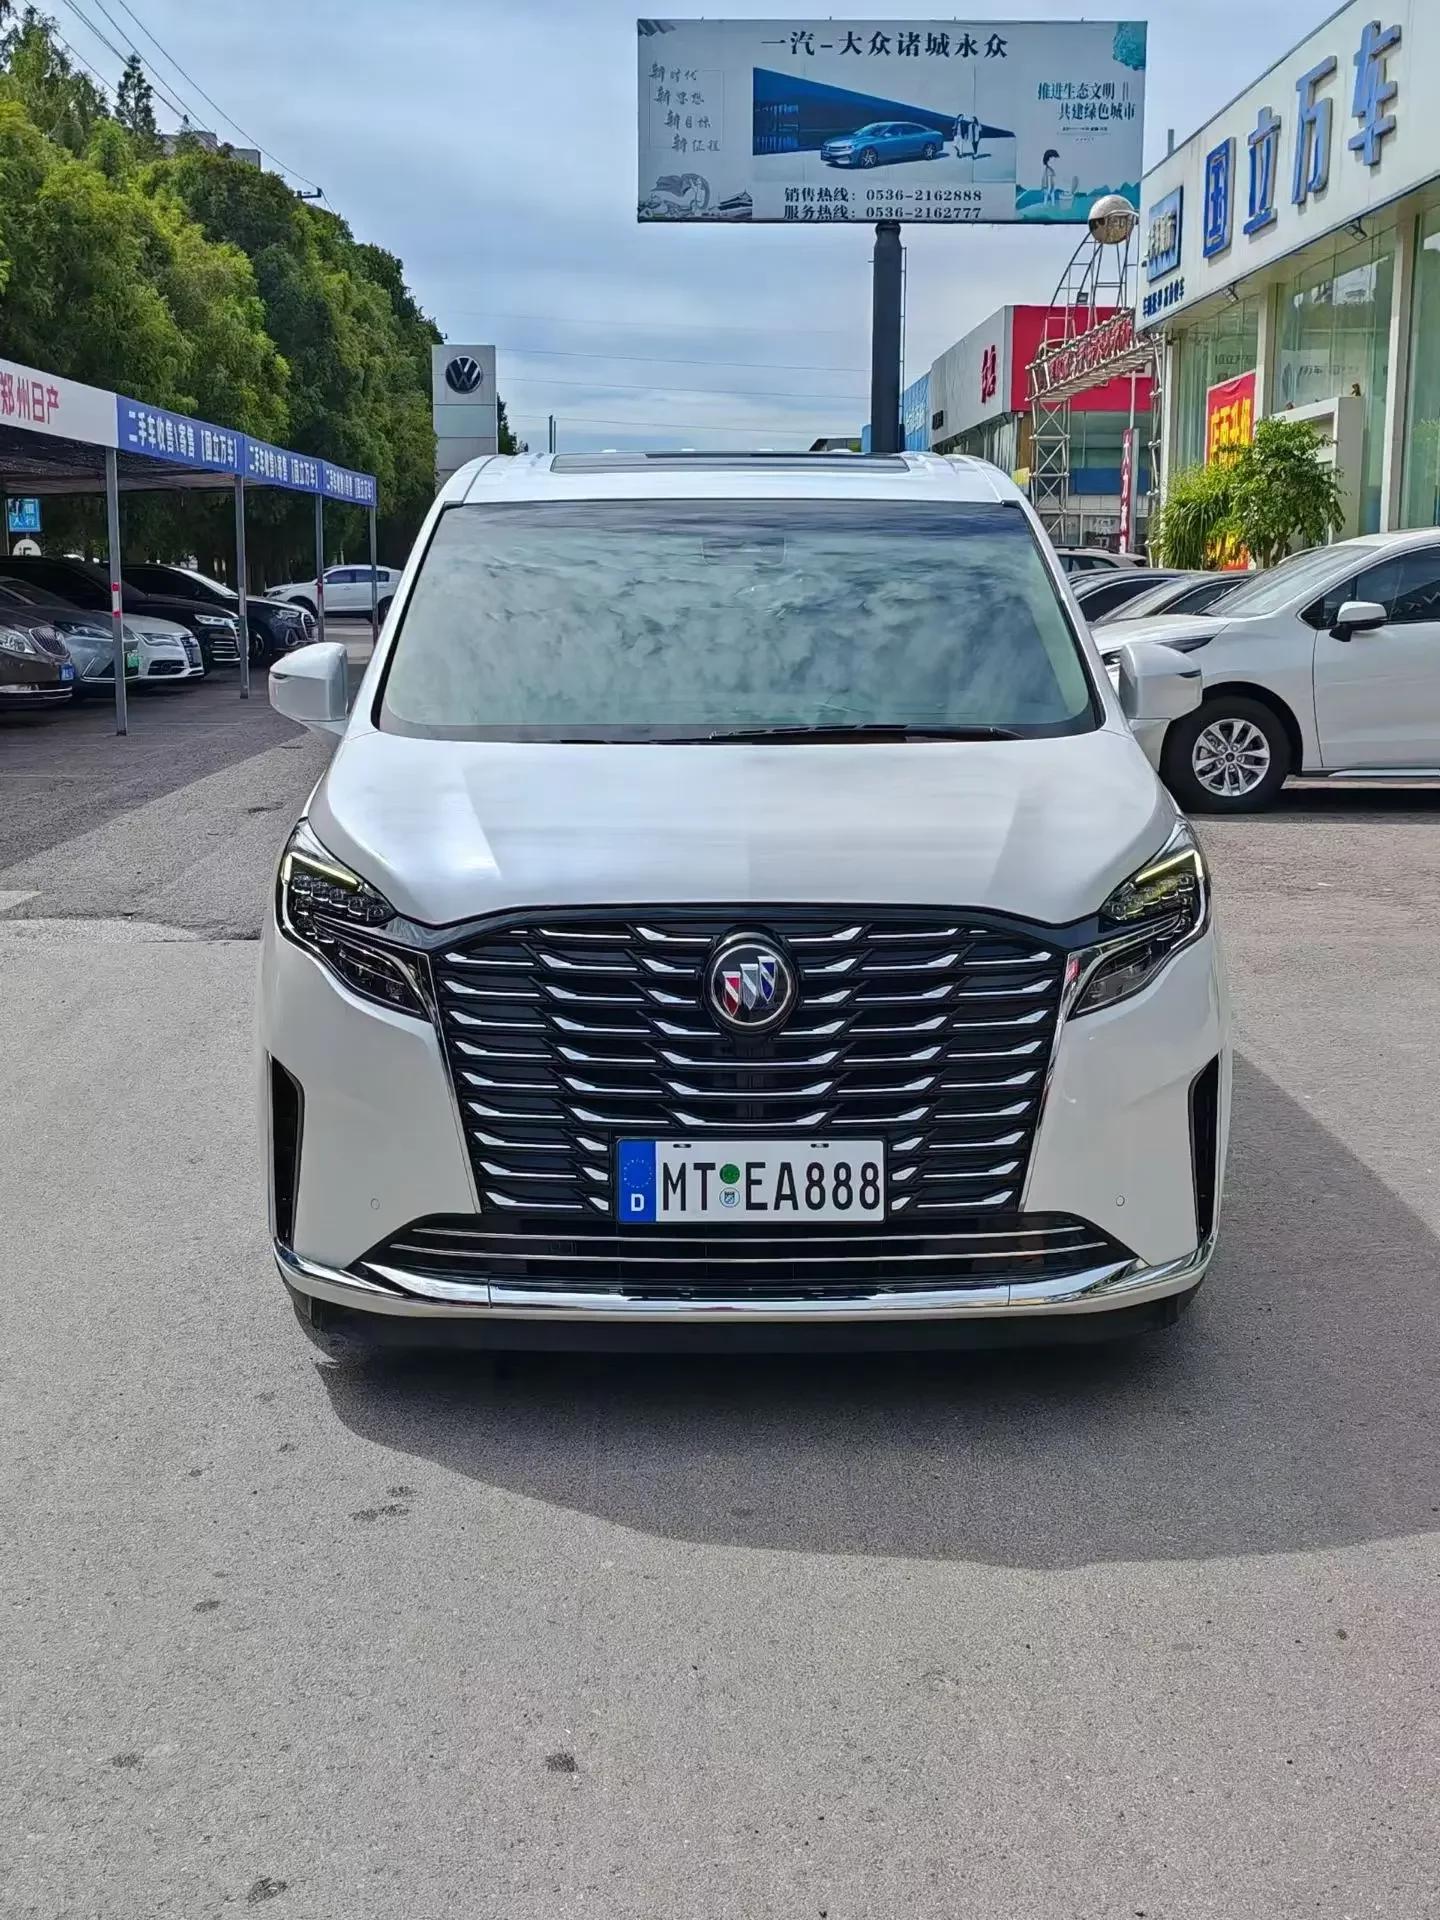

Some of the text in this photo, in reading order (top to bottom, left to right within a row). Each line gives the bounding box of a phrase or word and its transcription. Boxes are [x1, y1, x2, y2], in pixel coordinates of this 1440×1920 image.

[760, 30, 1009, 58] 一汽-大众诸城永众
[1037, 81, 1116, 100] 推进生态文明
[1057, 102, 1136, 121] 共建绿色城市
[865, 189, 982, 202] 0536-2162888
[865, 207, 982, 219] 0536-2162777
[630, 1161, 881, 1212] D MT EA888
